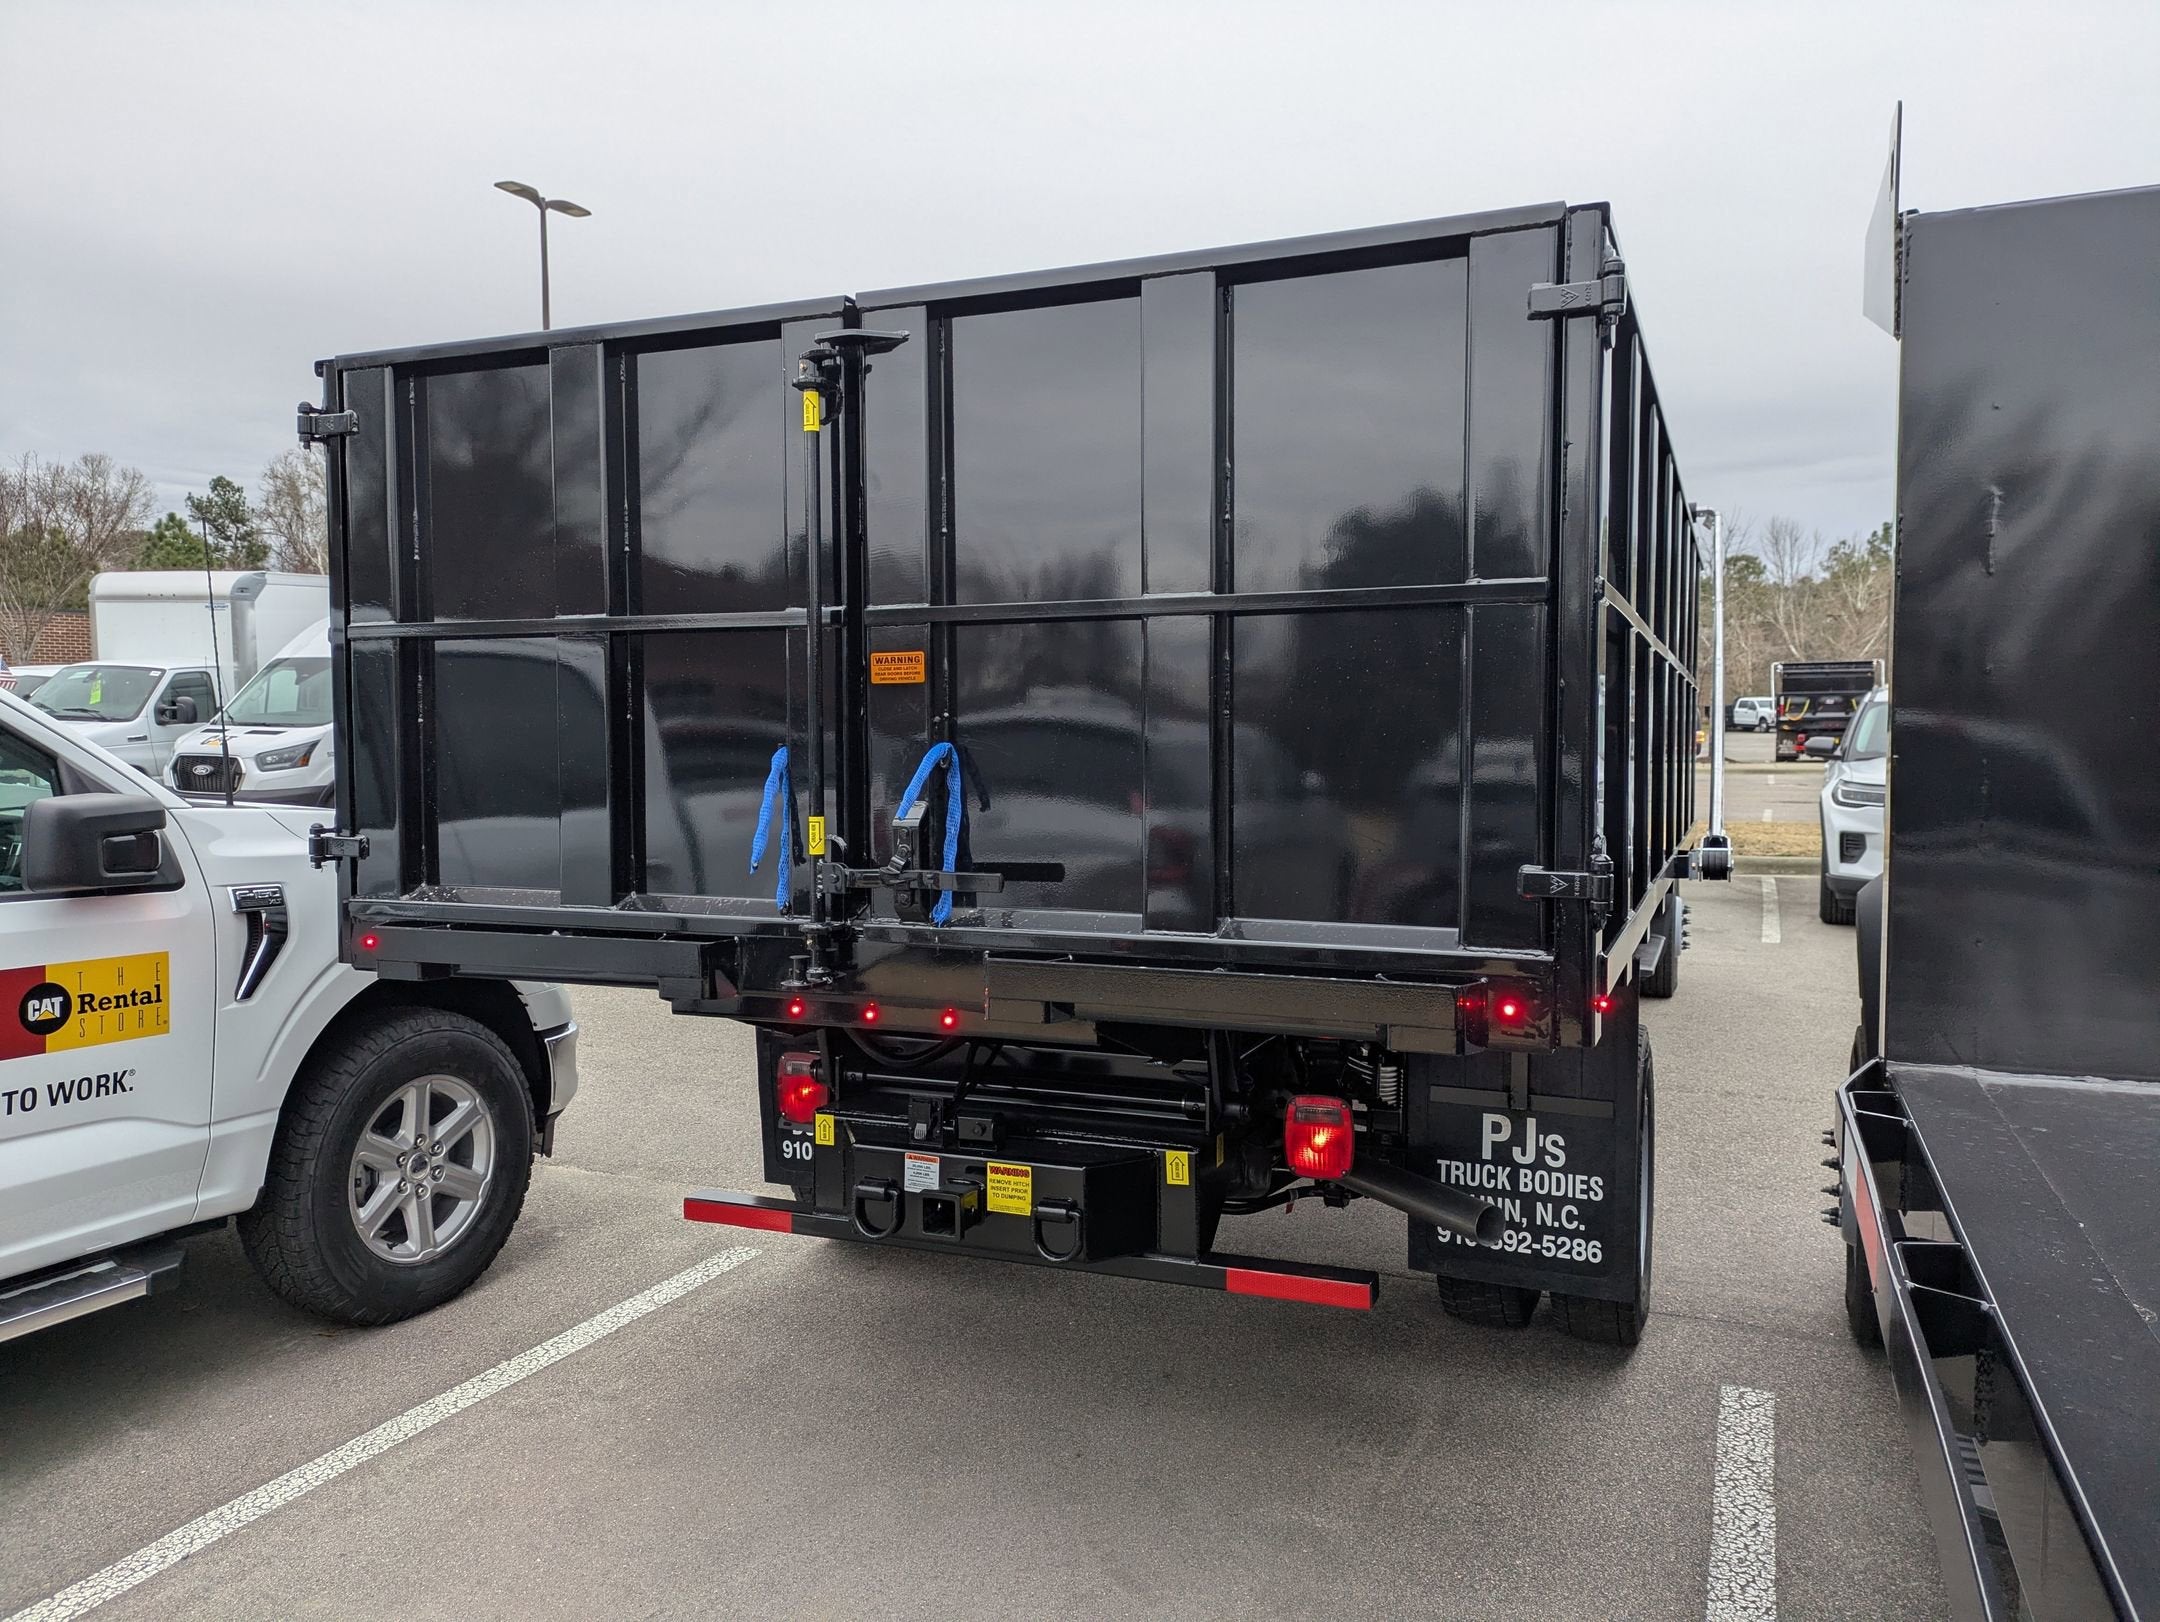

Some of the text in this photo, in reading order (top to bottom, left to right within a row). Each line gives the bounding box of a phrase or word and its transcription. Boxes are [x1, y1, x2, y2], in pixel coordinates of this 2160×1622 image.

[874, 656, 920, 664] WARNING
[77, 962, 161, 991] THE
[27, 996, 63, 1022] CAT
[77, 984, 163, 1014] Rental
[1, 1087, 38, 1116] TO
[1481, 1112, 1567, 1168] PJ'S
[989, 1165, 1030, 1178] WARNING
[1013, 1180, 1030, 1188] HITCH
[1436, 1159, 1604, 1201] TRUCK BODIES
[1001, 1193, 1026, 1201] DUMPING
[1536, 1201, 1586, 1231] N.C.
